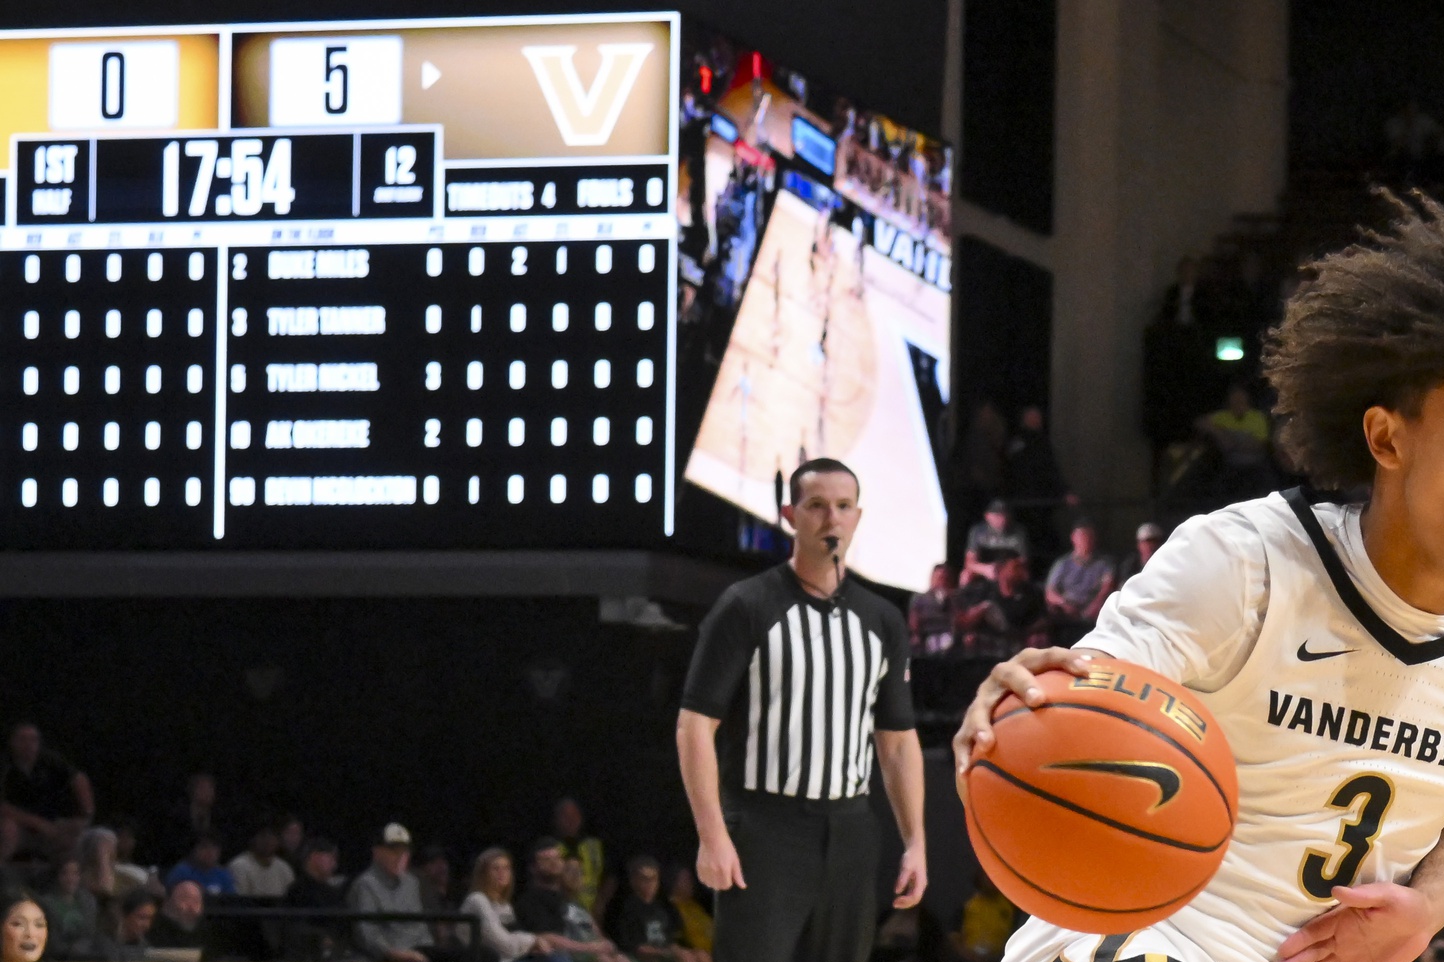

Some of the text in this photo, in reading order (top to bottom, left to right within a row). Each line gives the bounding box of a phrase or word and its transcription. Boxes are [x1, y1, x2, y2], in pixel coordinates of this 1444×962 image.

[101, 52, 125, 119] 0
[325, 47, 349, 114] 5
[35, 145, 78, 183] 1ST
[163, 139, 295, 216] 17:54
[385, 146, 416, 184] 12
[233, 254, 247, 280] 2
[1068, 664, 1207, 745] ELITE
[1297, 771, 1395, 901] 3
